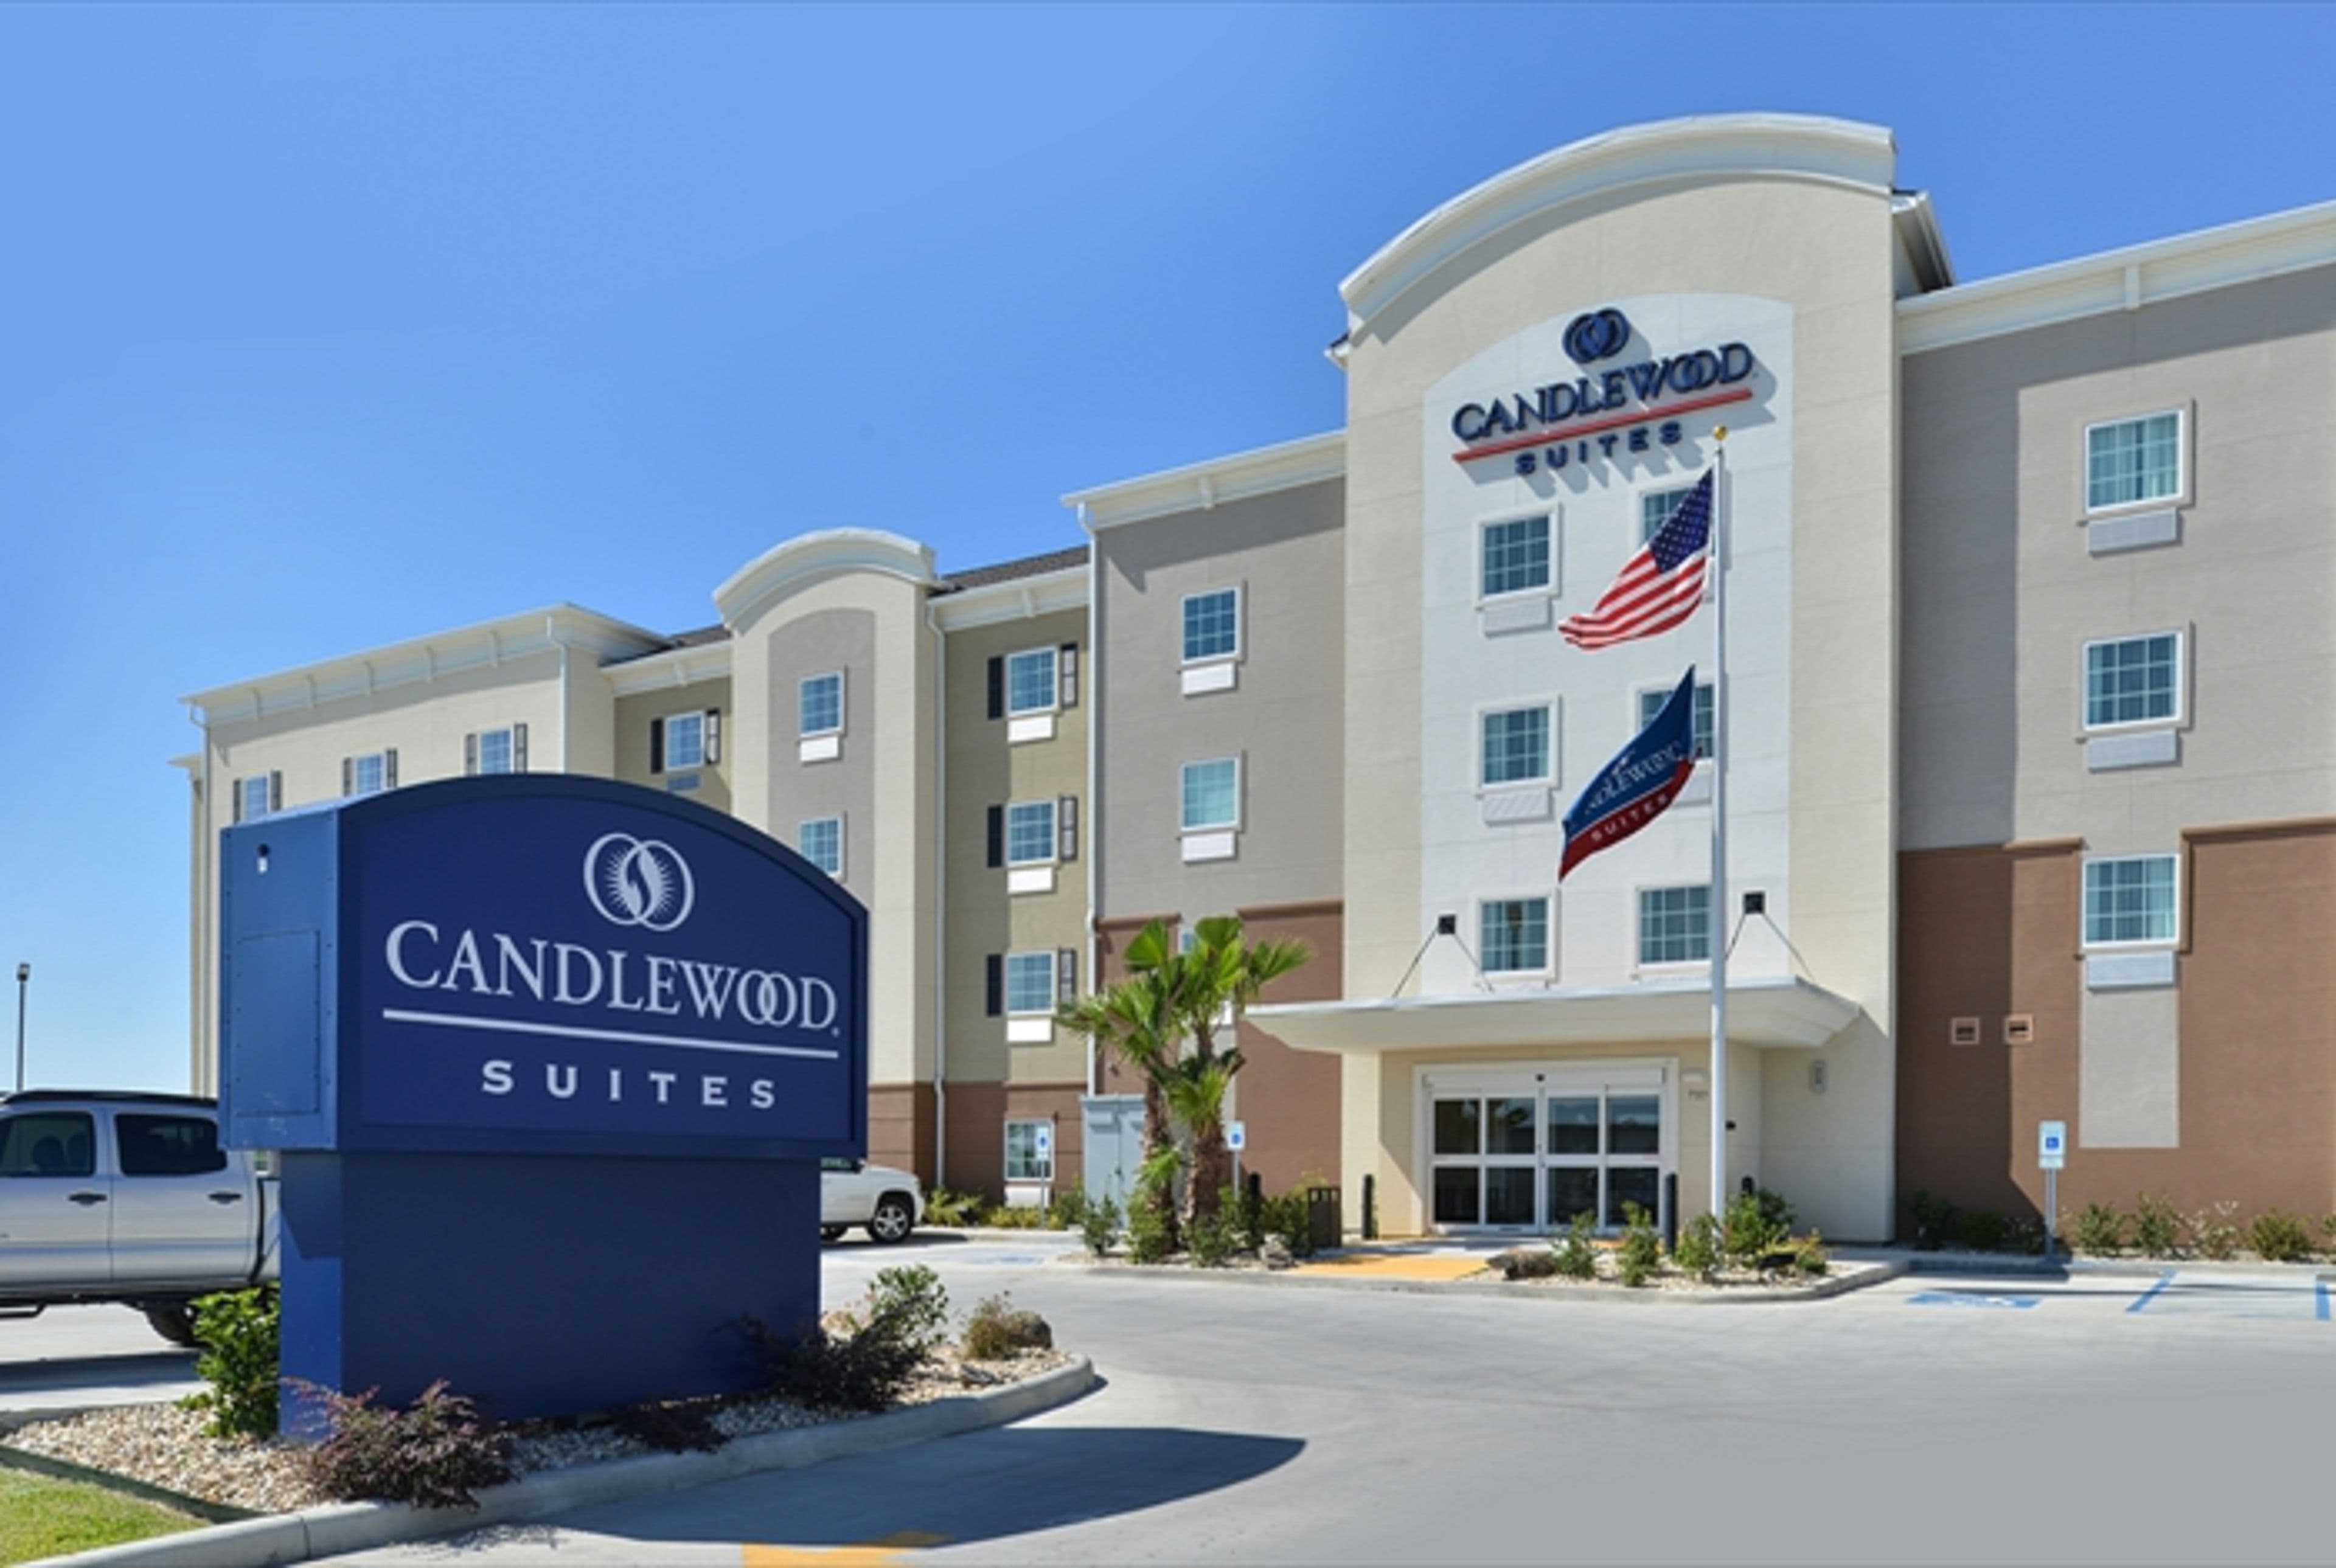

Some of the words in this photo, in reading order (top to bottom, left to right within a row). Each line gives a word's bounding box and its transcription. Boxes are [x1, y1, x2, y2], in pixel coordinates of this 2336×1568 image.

[1452, 342, 1753, 441] CANDLEWOOD
[1515, 421, 1682, 476] SUITES
[386, 920, 837, 1030] CANDLEWOOD
[482, 1060, 776, 1109] SUITES
